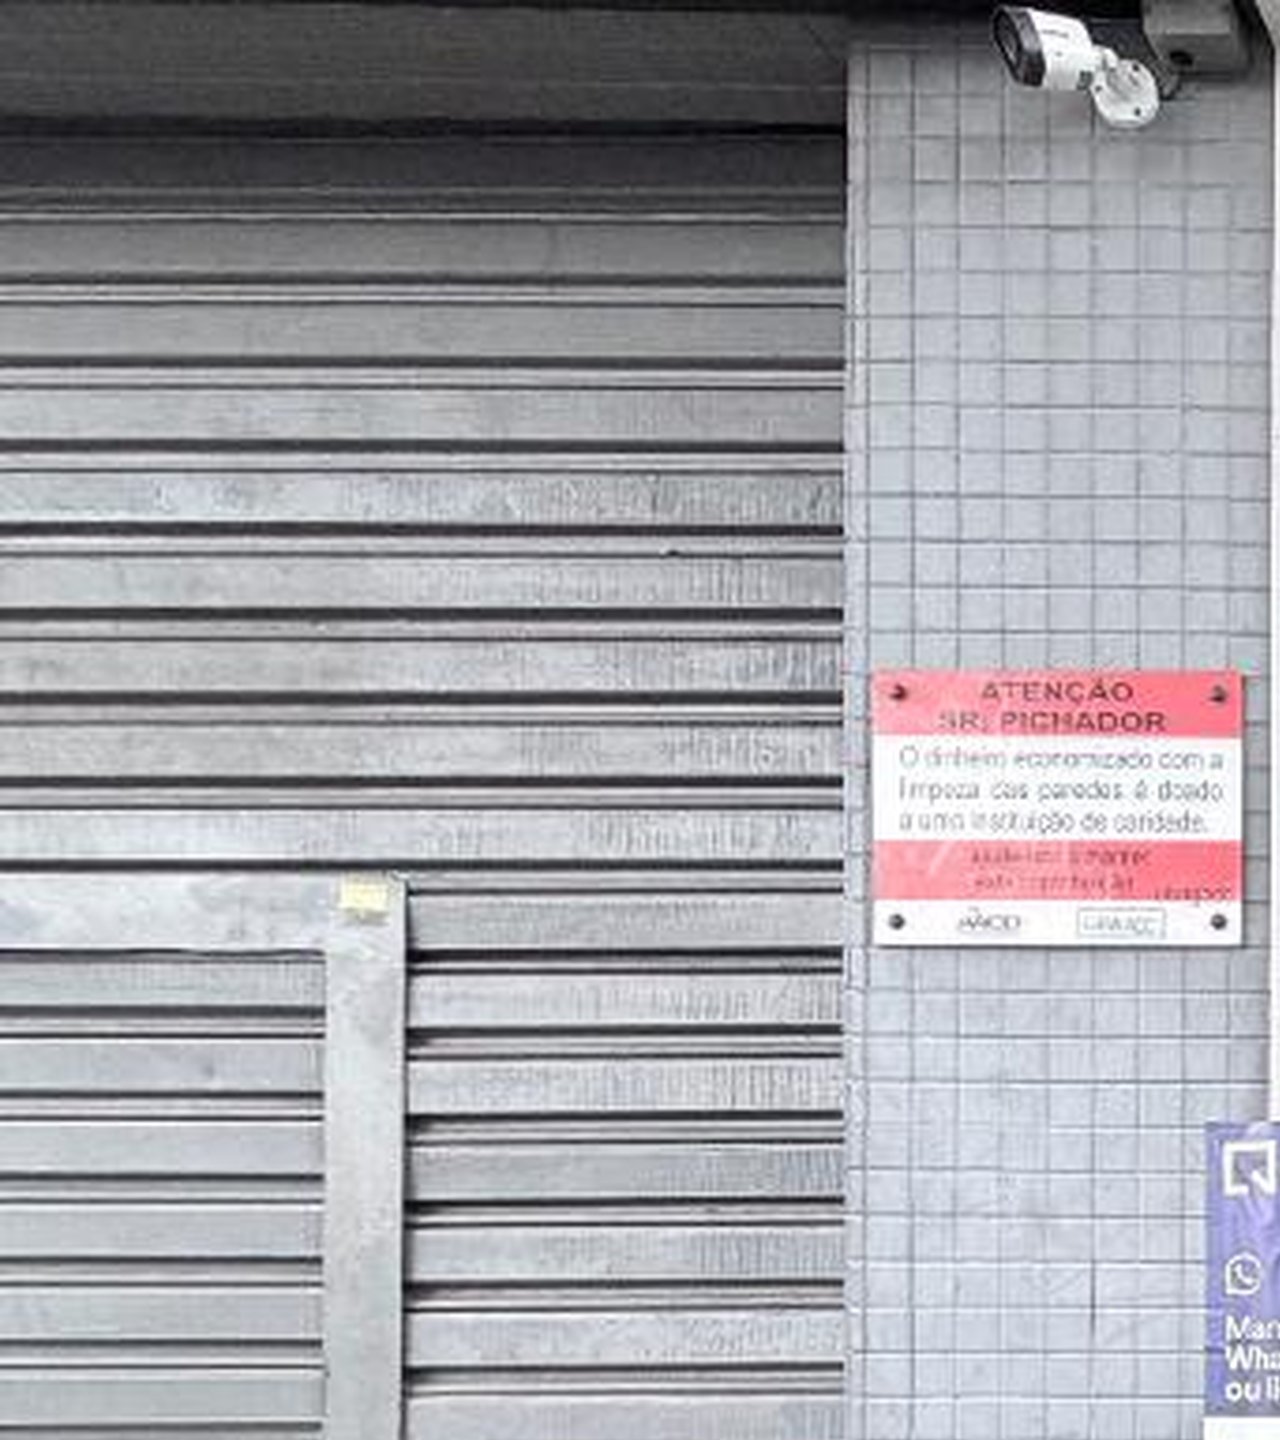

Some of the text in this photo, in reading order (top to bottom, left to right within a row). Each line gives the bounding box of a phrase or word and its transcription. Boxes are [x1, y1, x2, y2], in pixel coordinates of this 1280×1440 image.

[981, 680, 1135, 702] ATENÇÃO
[1000, 711, 1167, 732] PICHADOR
[899, 745, 920, 768] O
[1013, 748, 1154, 770] economizado
[1158, 751, 1205, 770] com
[1209, 752, 1224, 770] a
[899, 776, 981, 805] limpeza
[1037, 778, 1124, 804] paredes
[1158, 778, 1224, 801] doado
[899, 812, 913, 832] a
[918, 812, 966, 832] uma
[1080, 810, 1108, 833] de
[1225, 1381, 1261, 1402] ou
